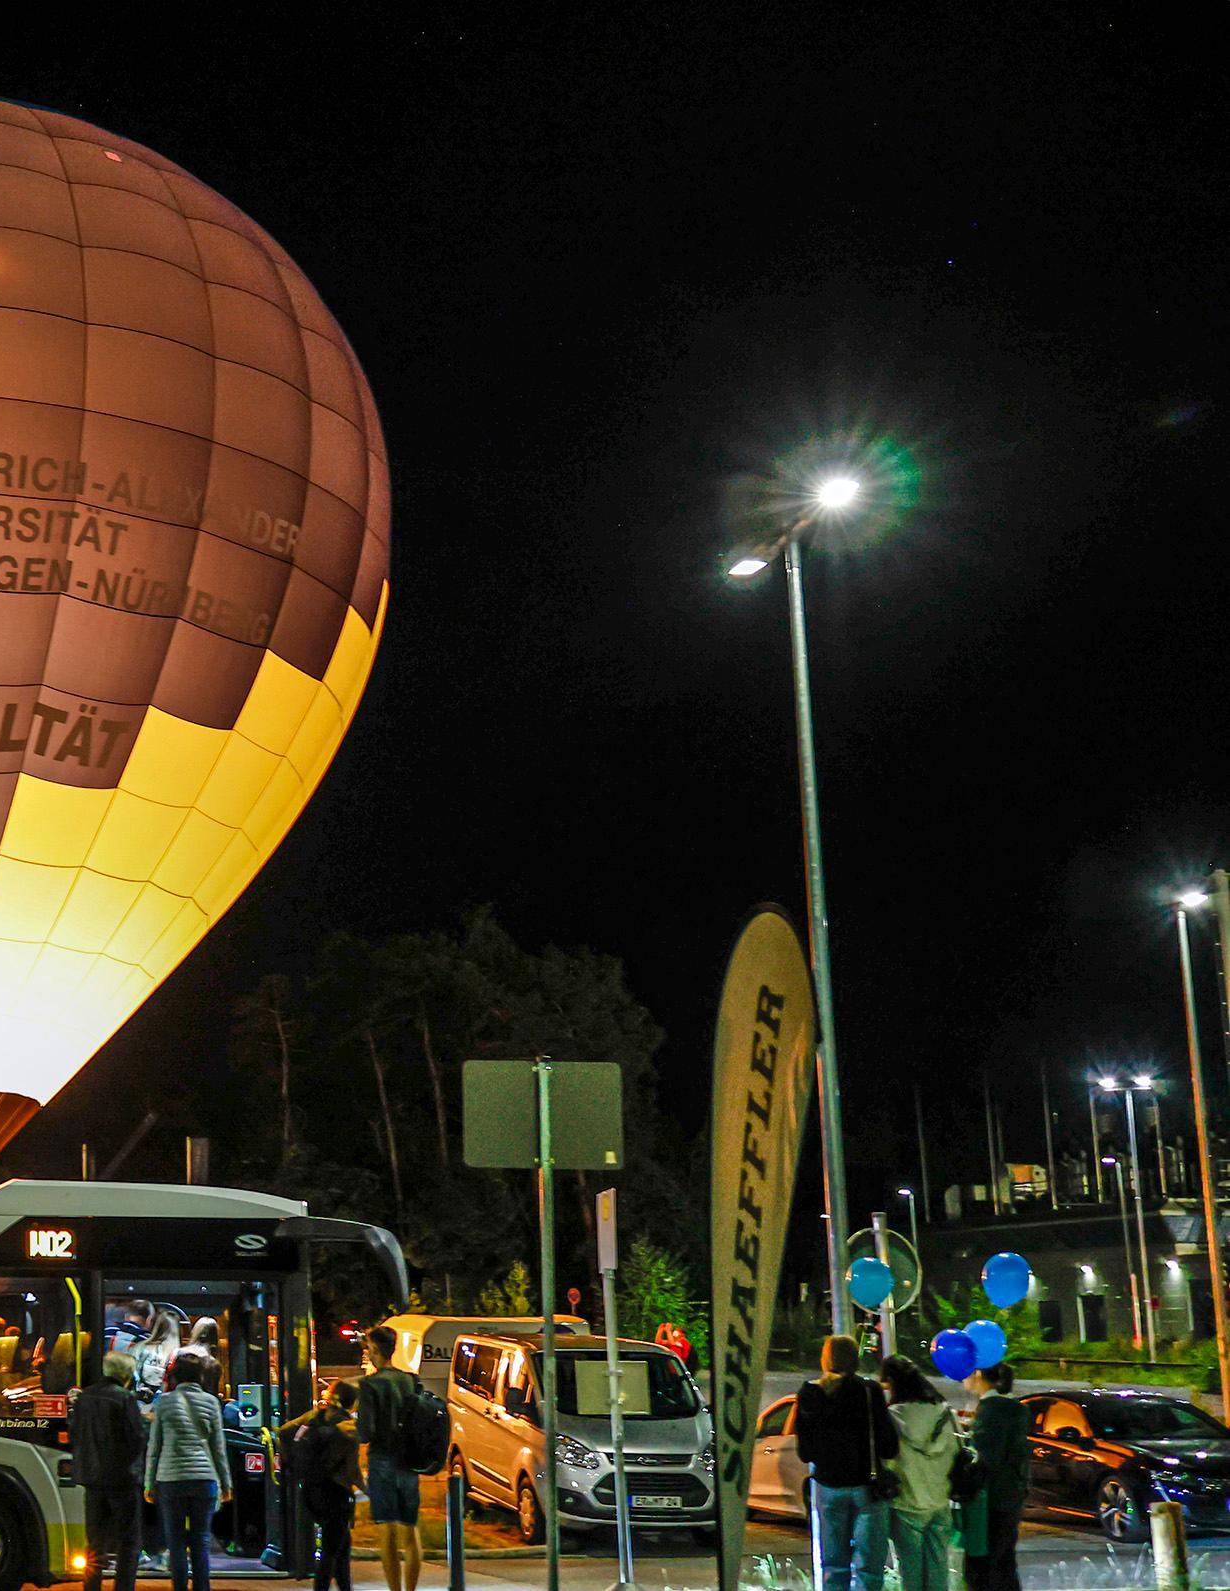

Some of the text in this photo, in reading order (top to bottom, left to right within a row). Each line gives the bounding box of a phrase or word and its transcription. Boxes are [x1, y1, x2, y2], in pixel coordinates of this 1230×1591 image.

[723, 984, 785, 1497] SCHAEFFLER
[423, 1343, 454, 1359] BAL
[37, 1418, 49, 1429] 12
